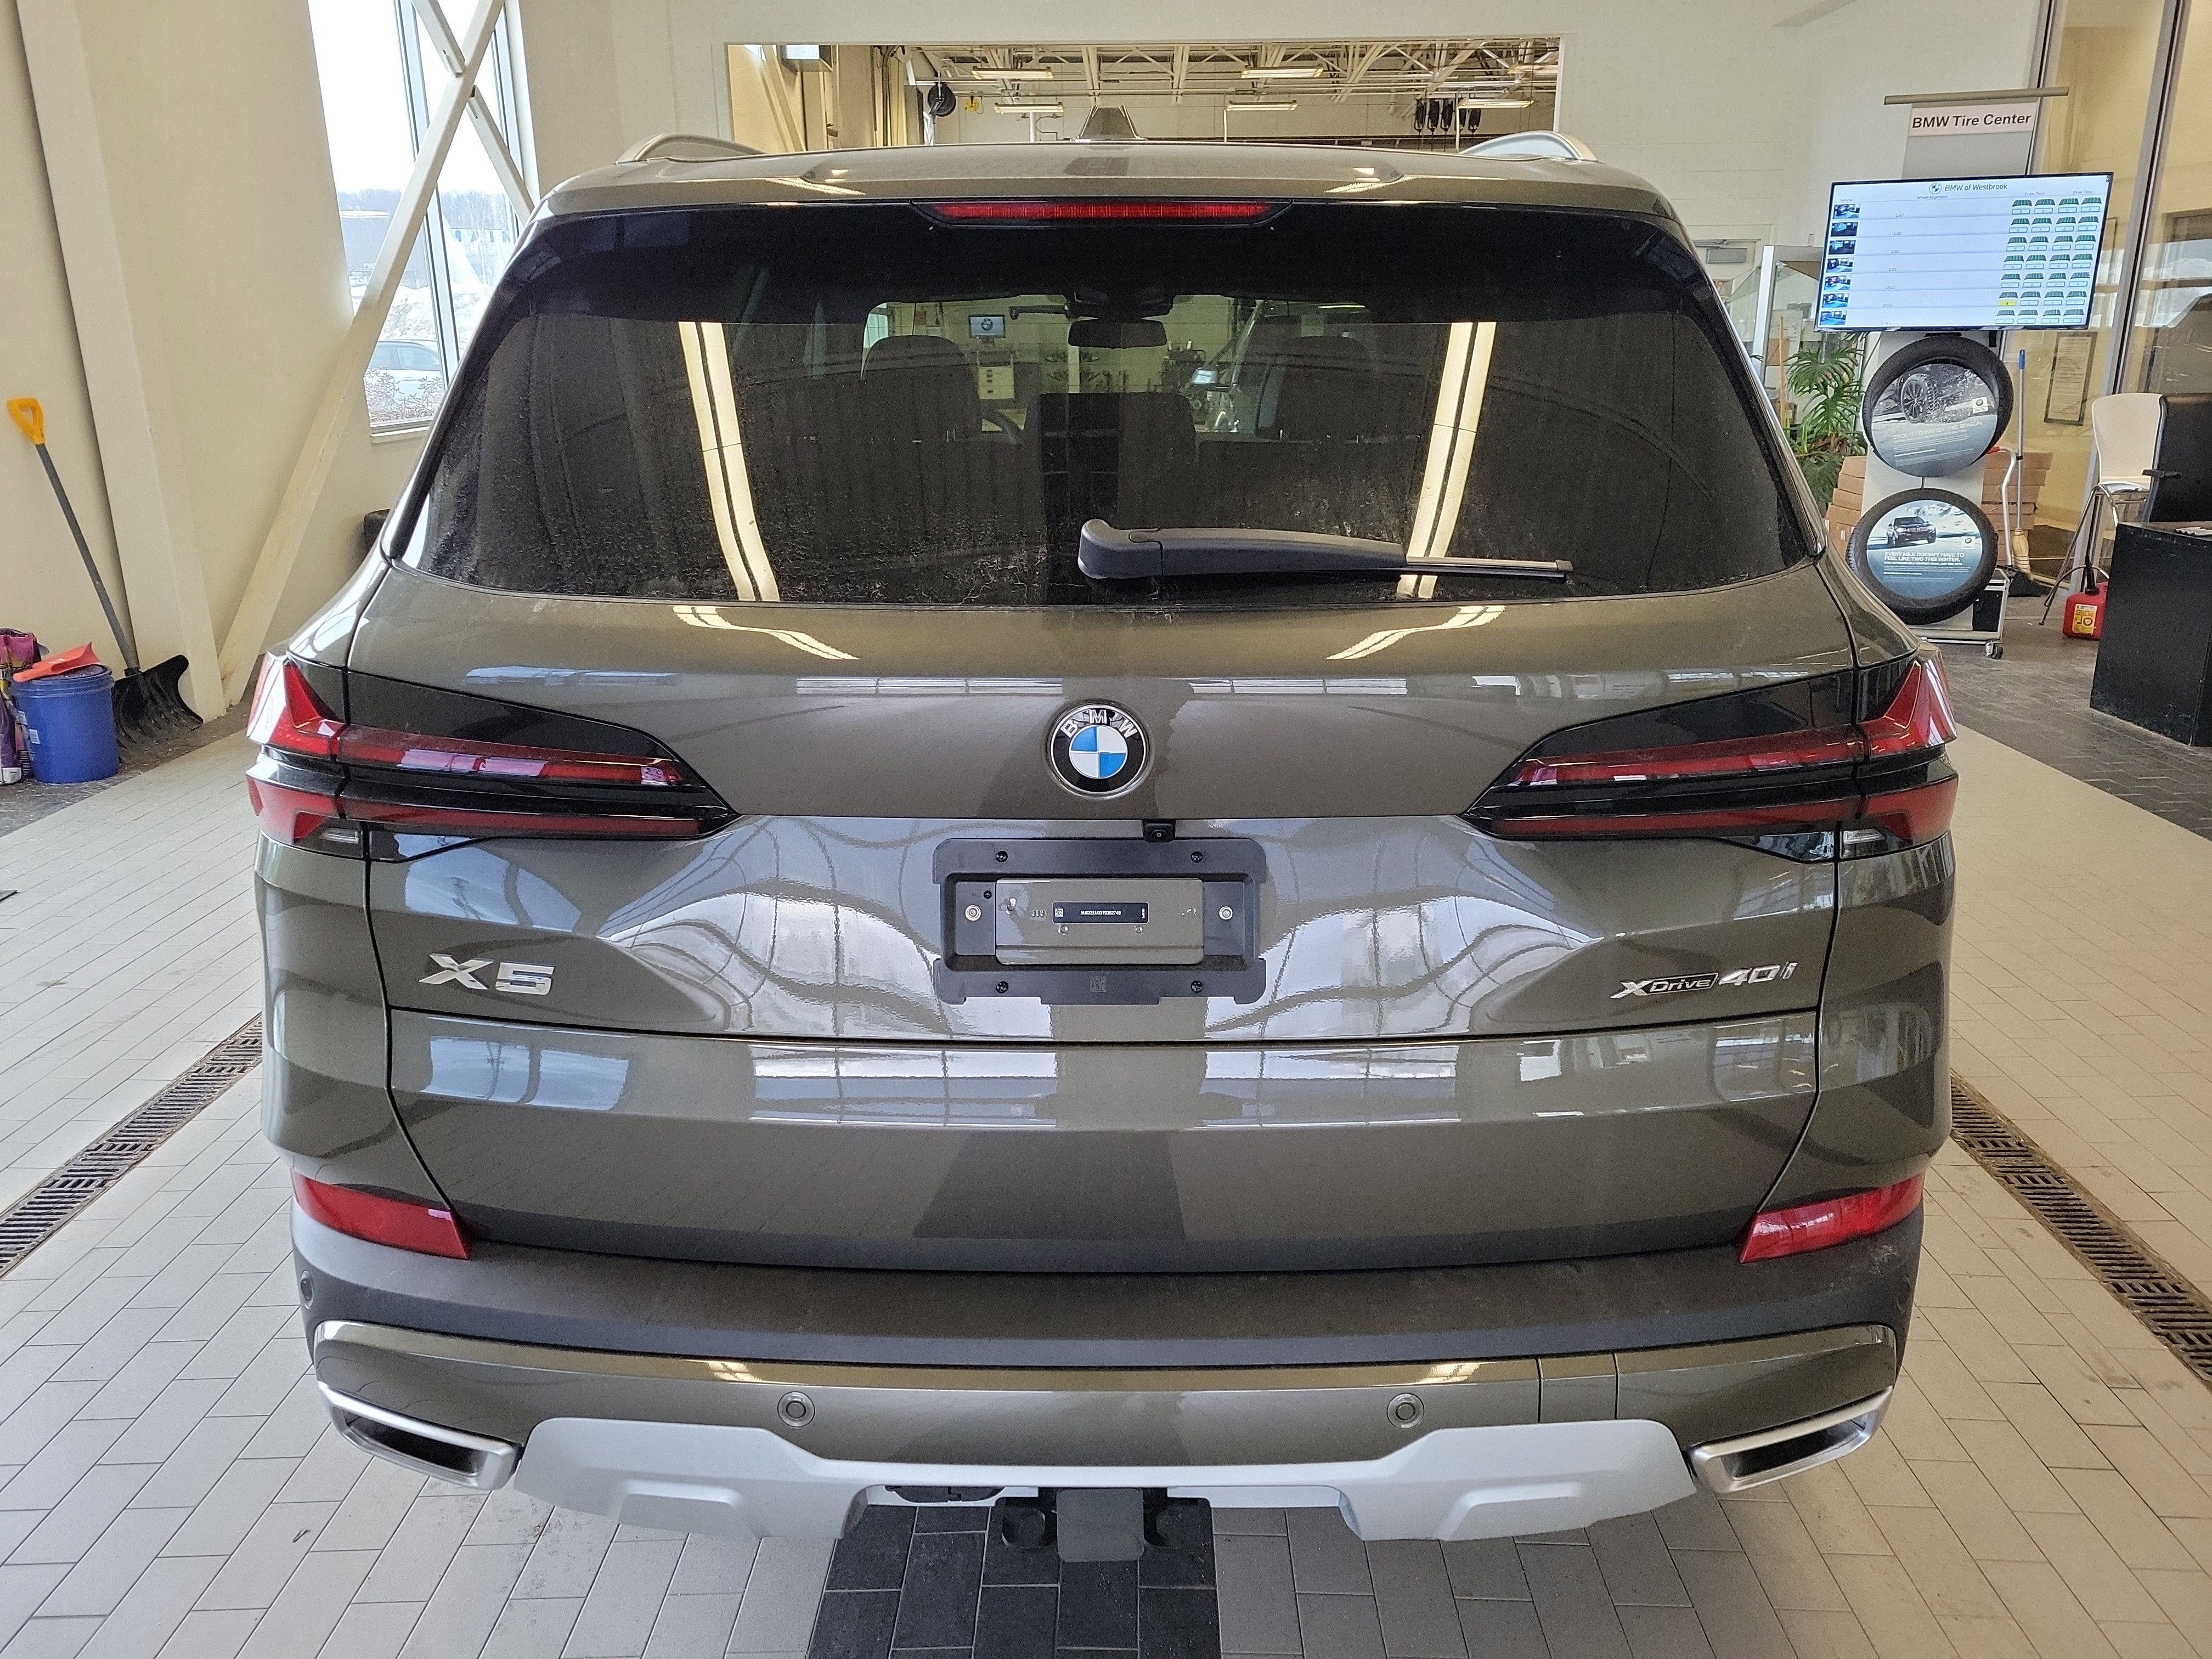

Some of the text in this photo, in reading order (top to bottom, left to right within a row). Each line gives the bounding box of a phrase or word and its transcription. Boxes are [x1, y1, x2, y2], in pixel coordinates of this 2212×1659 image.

[1912, 114, 2032, 128] BMW Tire Center
[1060, 709, 1138, 738] BMW
[418, 952, 556, 996] X5
[1717, 961, 1798, 986] 40i
